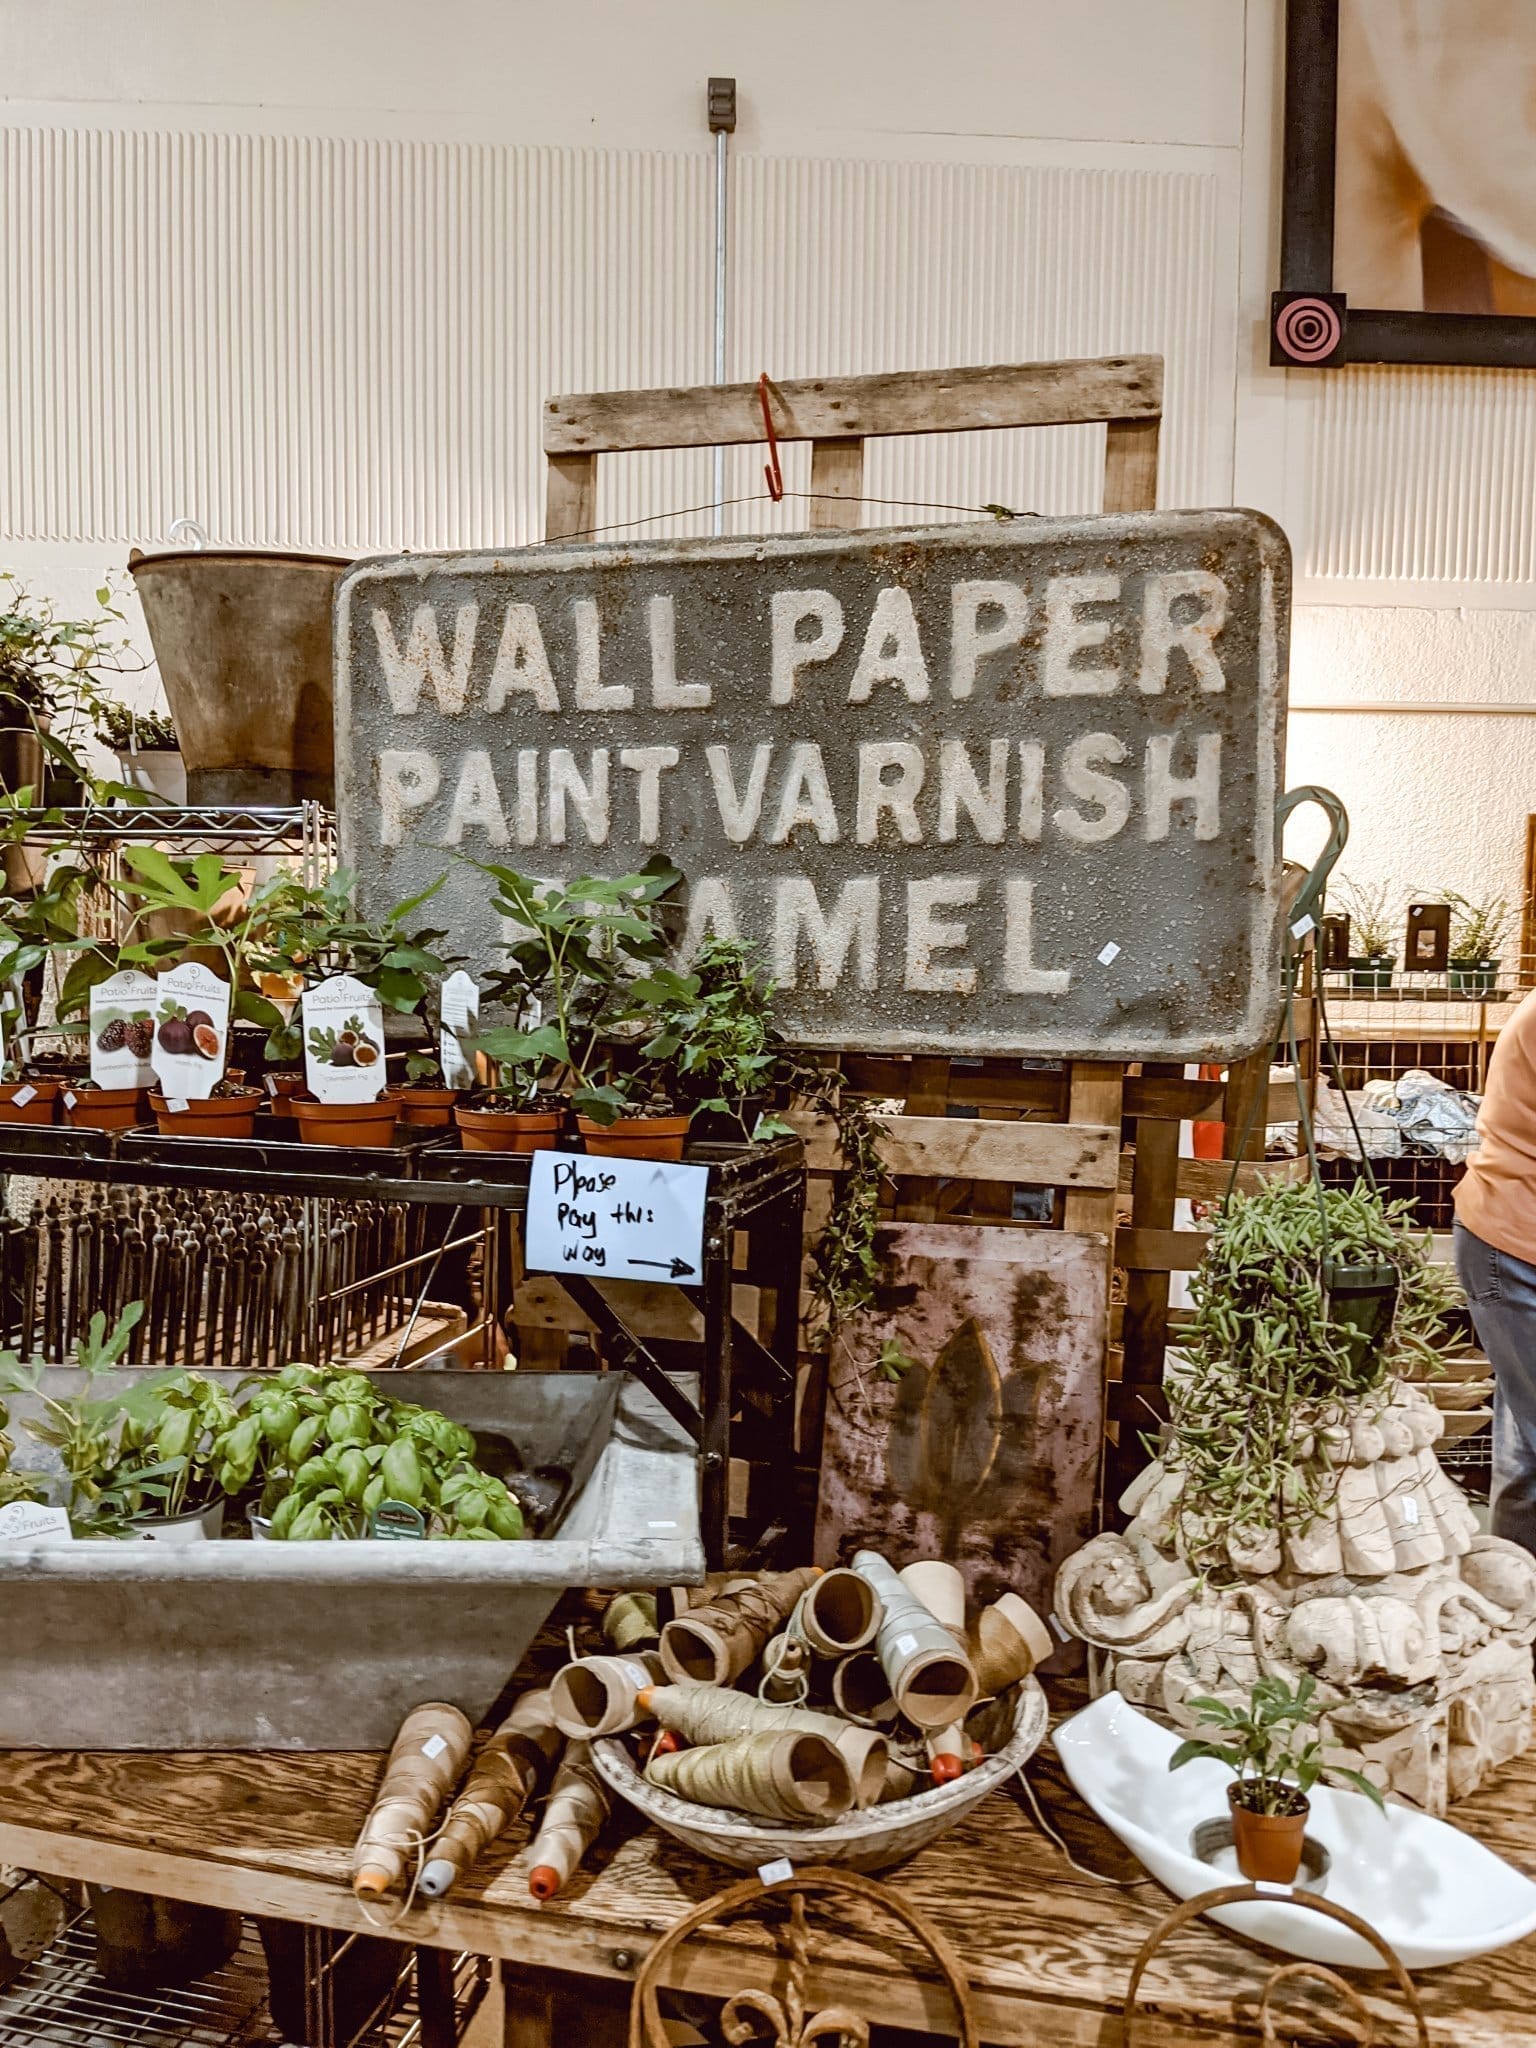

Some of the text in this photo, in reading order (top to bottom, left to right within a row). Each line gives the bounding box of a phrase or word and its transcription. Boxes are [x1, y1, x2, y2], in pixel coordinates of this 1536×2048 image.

[371, 570, 1229, 715] WALL PAPER
[378, 732, 1223, 848] PAINT VARNISH
[100, 985, 128, 997] Patio
[167, 977, 222, 995] Patio Fruits
[312, 992, 371, 1004] Patio Fruits
[23, 1516, 57, 1530] Fruits
